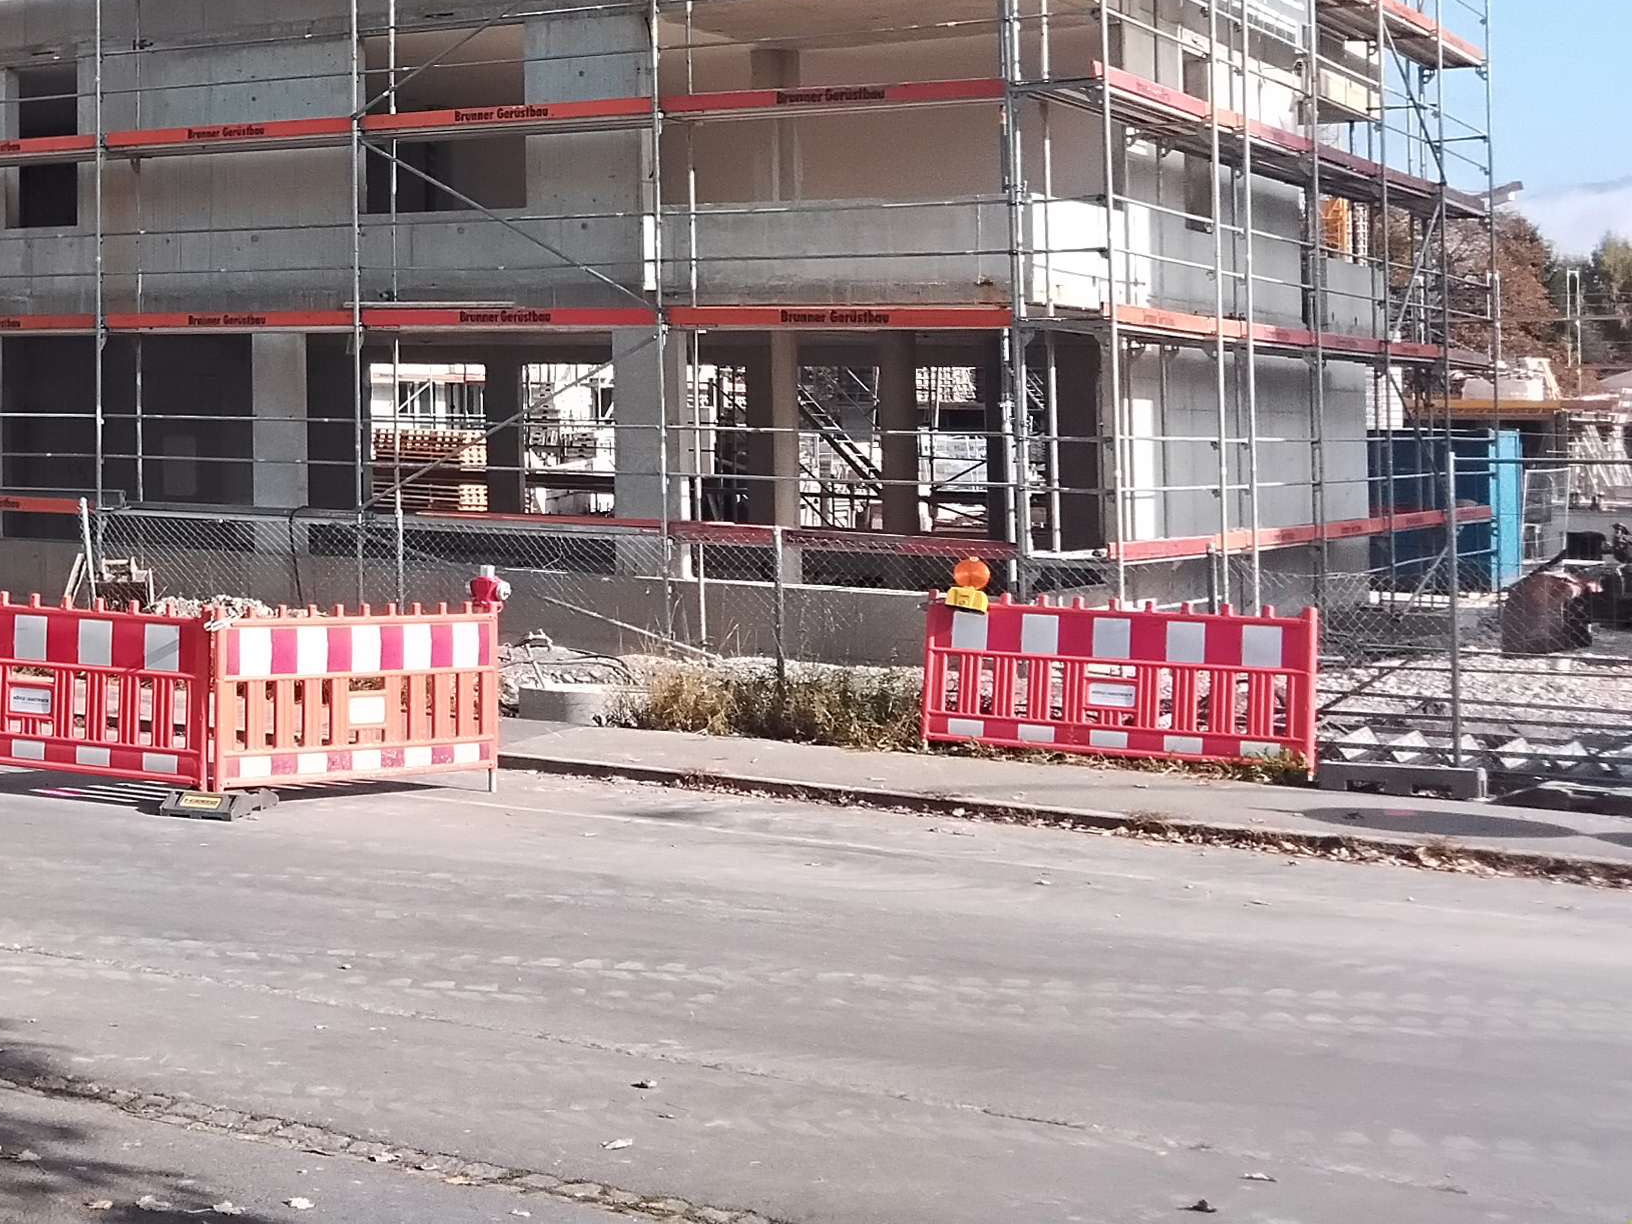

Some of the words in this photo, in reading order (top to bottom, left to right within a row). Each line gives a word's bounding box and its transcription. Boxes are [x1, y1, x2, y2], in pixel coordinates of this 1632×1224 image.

[776, 90, 823, 104] Brunner
[825, 87, 885, 101] Gerüstbau
[455, 111, 494, 123] Brunner
[496, 106, 548, 119] Gerüstbau
[188, 127, 221, 139] Brunner
[222, 124, 266, 136] Gerüstbau
[188, 314, 221, 326] Brunner
[222, 314, 267, 326] Gerüstbau
[459, 311, 499, 323] Brunner
[500, 310, 551, 323] Gerüstbau
[780, 310, 825, 323] Brunner
[830, 309, 889, 323] Gerüstbau
